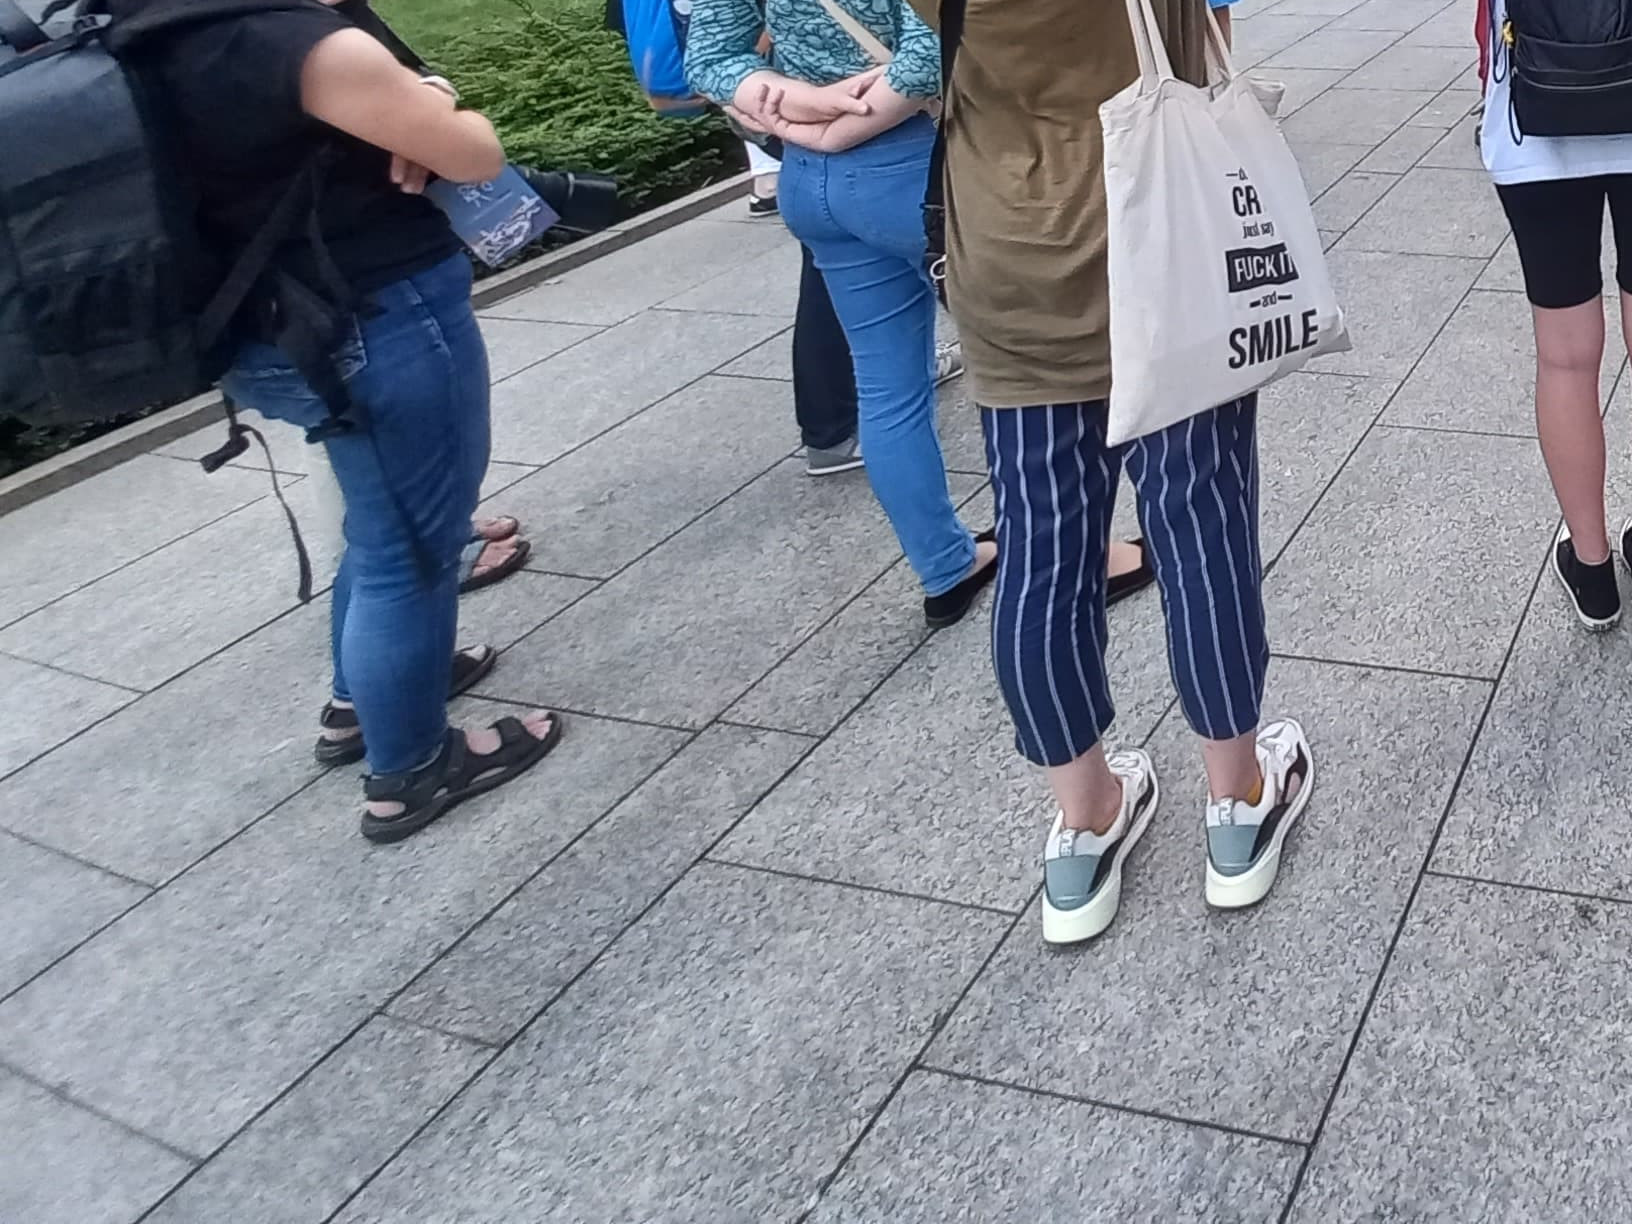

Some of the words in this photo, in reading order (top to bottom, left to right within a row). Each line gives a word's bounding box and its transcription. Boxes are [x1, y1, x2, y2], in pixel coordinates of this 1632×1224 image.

[1242, 220, 1260, 239] just
[1260, 221, 1275, 237] say
[1233, 253, 1278, 283] FUCK
[1228, 308, 1319, 370] SMILE
